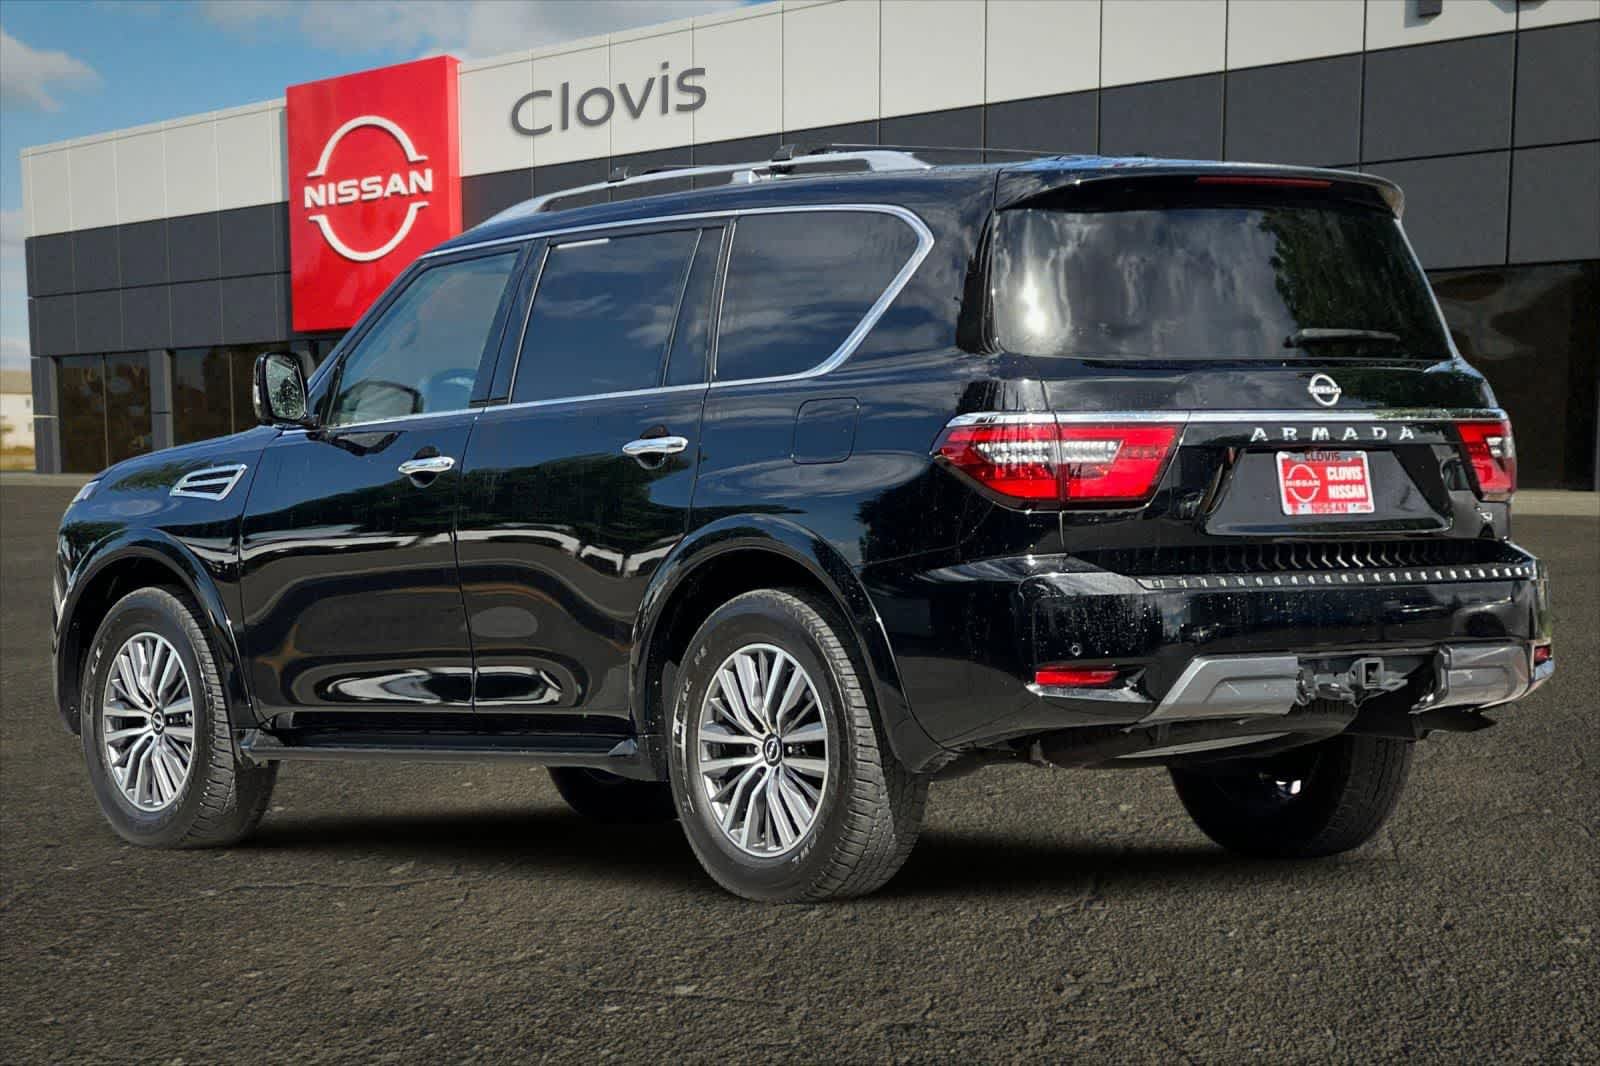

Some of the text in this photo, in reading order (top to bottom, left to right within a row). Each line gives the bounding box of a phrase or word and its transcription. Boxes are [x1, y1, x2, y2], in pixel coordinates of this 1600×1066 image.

[510, 61, 707, 137] Clovis
[303, 167, 433, 209] NISSAN
[1308, 386, 1342, 394] NISSAN
[1250, 426, 1416, 442] ARMADA
[1304, 450, 1341, 461] CLOVIS
[1326, 466, 1363, 480] CLOVIS
[1285, 479, 1321, 488] NISSAN
[1327, 484, 1367, 499] NISSAN
